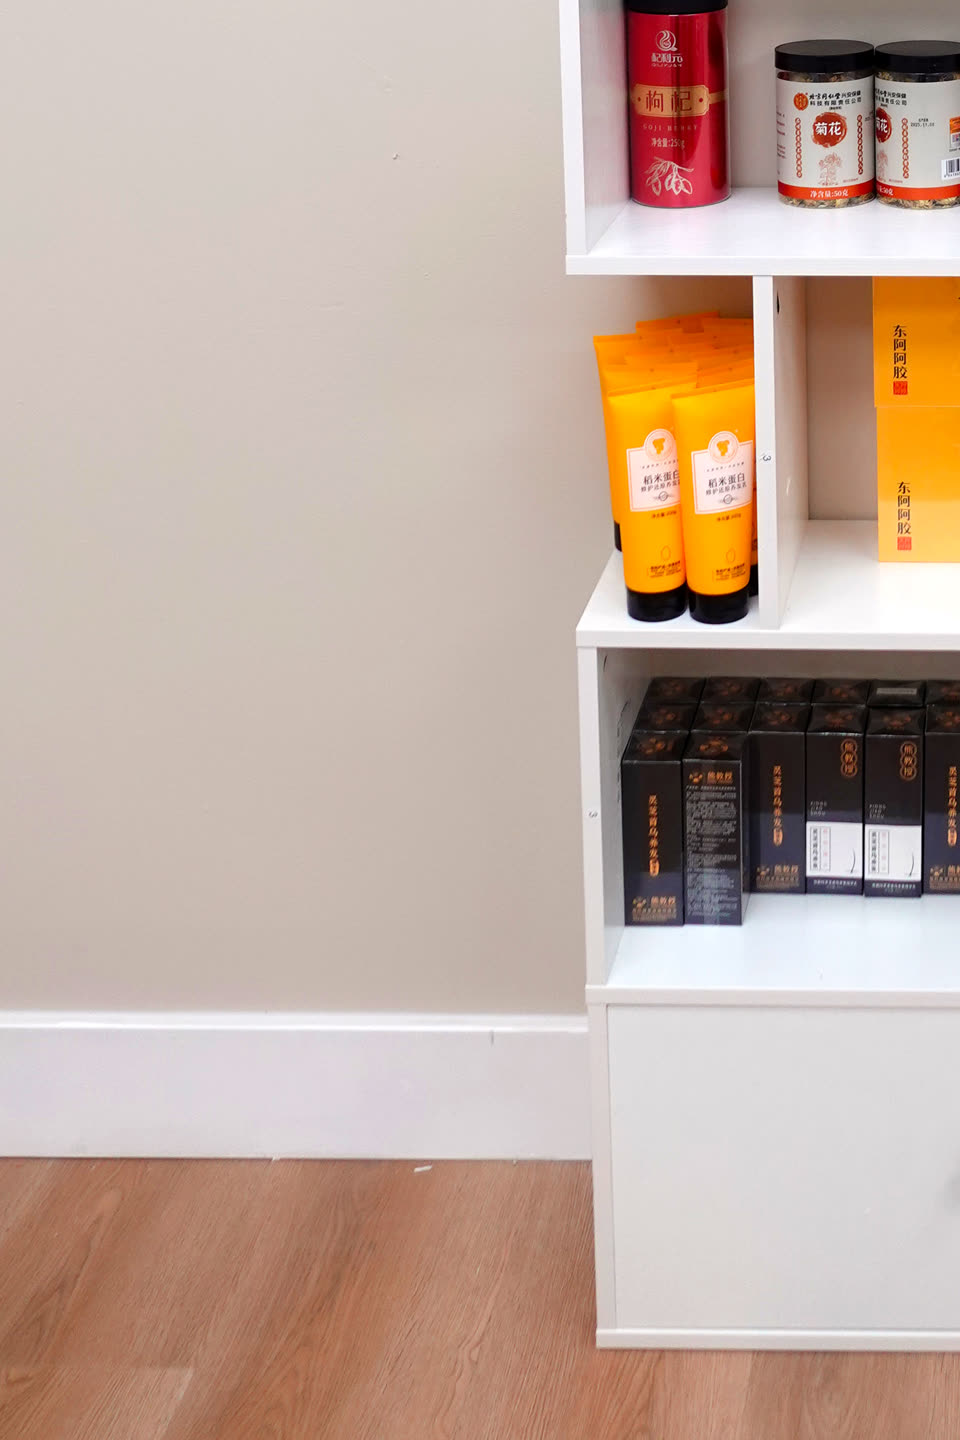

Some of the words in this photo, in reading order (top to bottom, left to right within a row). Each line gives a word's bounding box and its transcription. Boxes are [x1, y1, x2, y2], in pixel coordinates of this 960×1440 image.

[646, 90, 692, 112] 枸杞
[810, 97, 861, 106] 科技有限责任公司
[815, 122, 842, 136] 菊花
[810, 189, 848, 198] 净含量:50克
[893, 325, 907, 379] 东阿阿胶
[643, 470, 680, 485] 稻米蛋白
[708, 472, 745, 488] 稻米蛋白
[897, 481, 911, 535] 东阿阿胶
